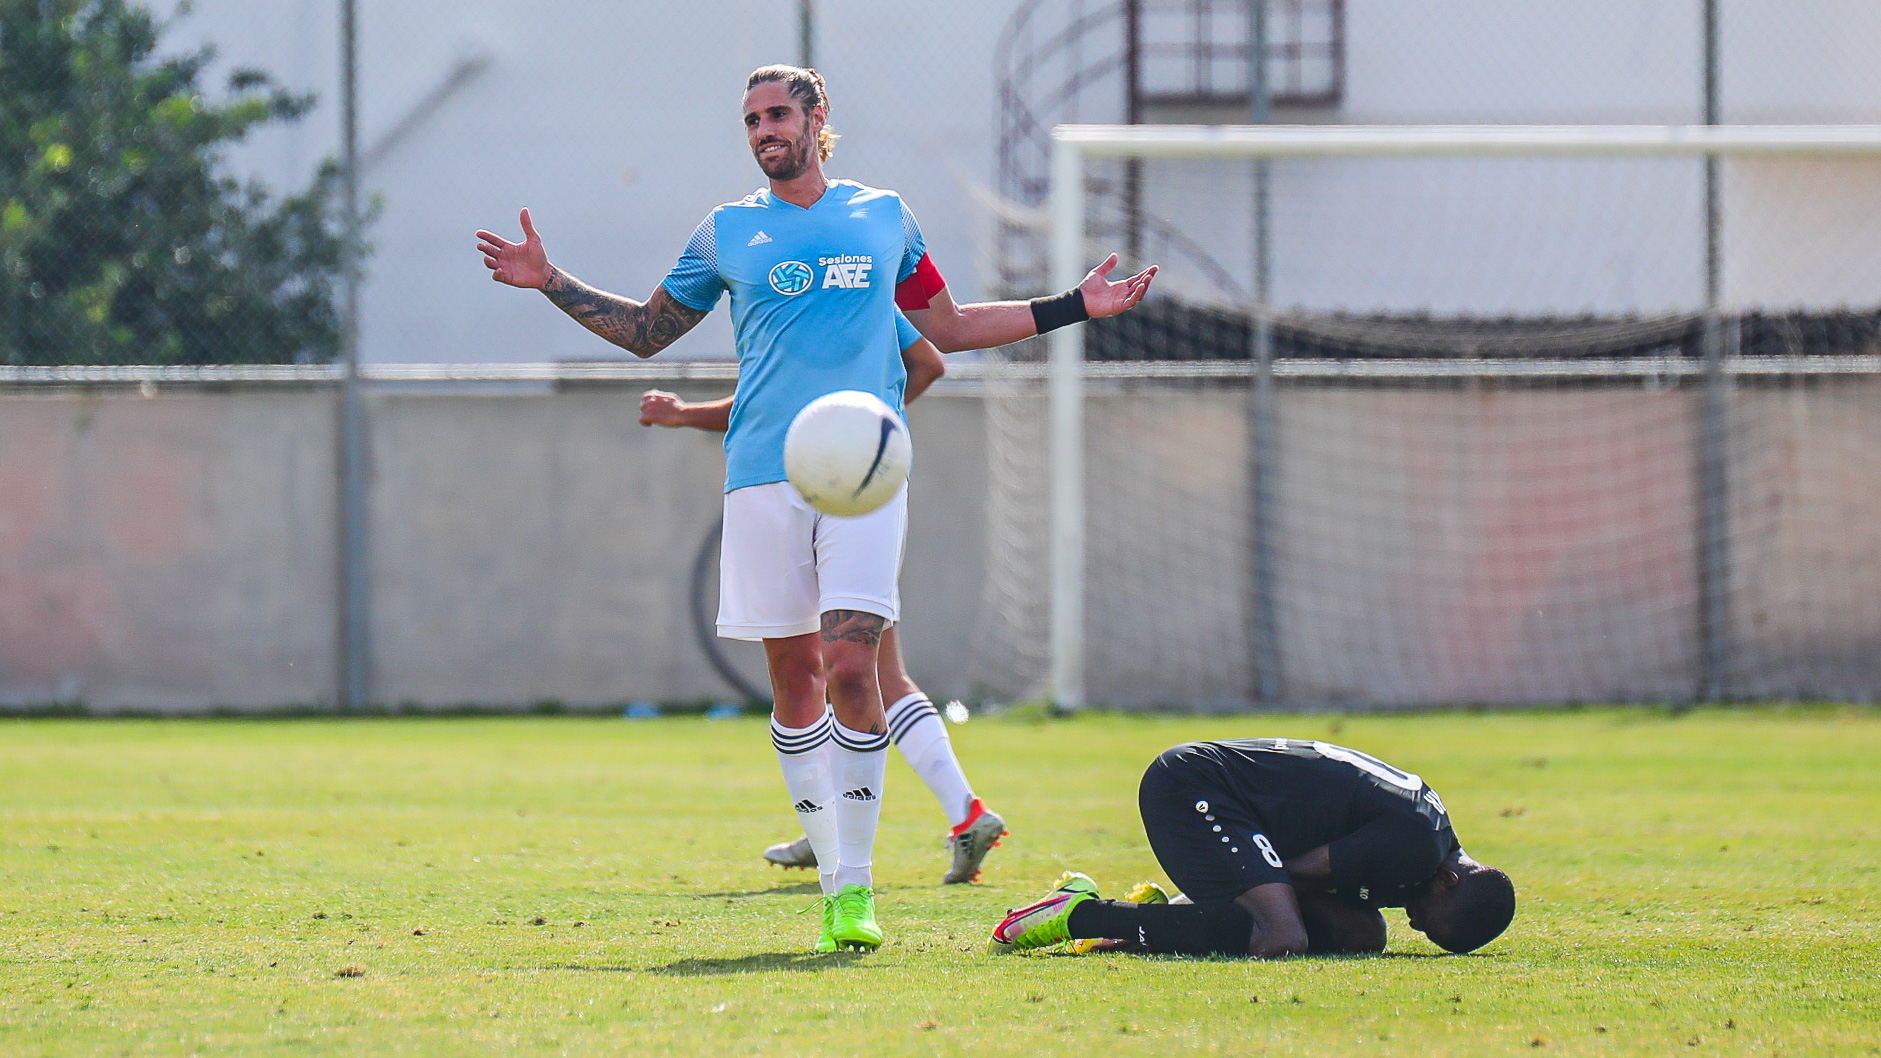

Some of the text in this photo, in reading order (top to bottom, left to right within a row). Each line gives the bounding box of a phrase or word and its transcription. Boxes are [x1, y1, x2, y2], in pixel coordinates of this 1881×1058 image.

[818, 253, 873, 267] Sesiones
[821, 263, 873, 289] AFE
[1252, 833, 1283, 868] 8
